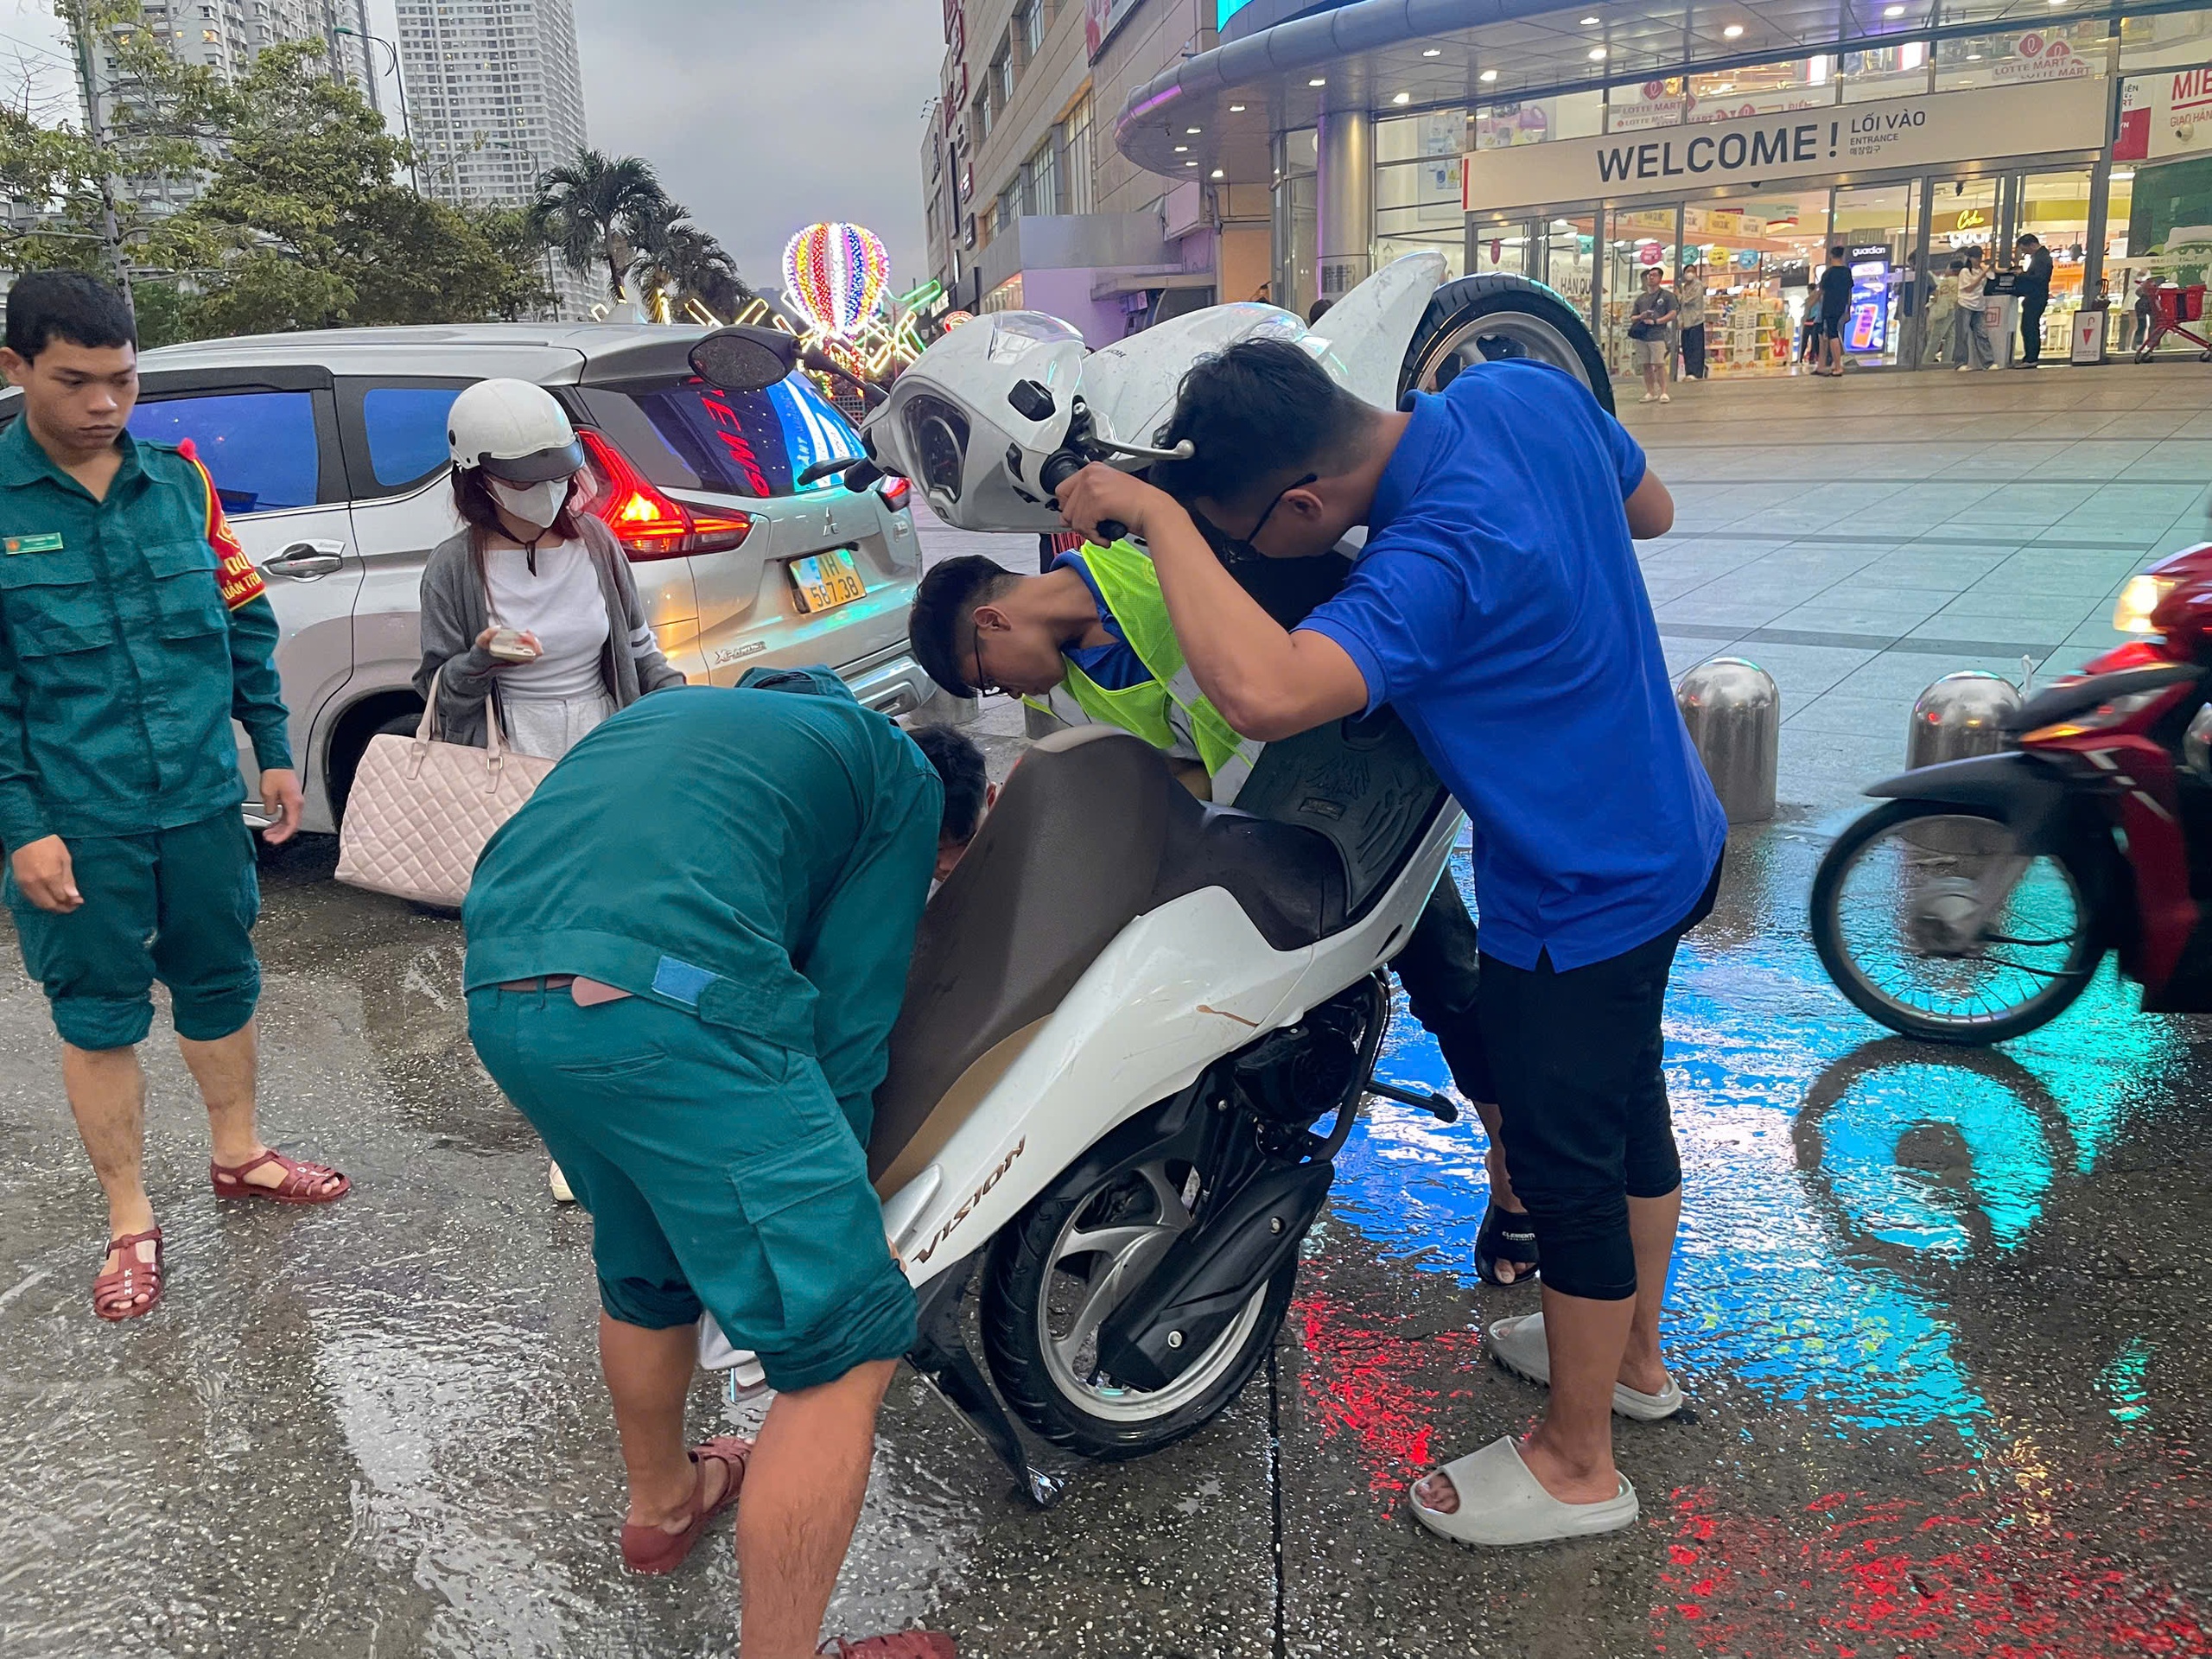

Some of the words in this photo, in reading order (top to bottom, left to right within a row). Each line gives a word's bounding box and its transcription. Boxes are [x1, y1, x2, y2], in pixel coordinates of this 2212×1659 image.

[1995, 64, 2031, 75] LOTTE
[2033, 58, 2066, 69] MART
[1623, 105, 1651, 114] LOTTE
[1654, 101, 1682, 111] MART
[1851, 112, 1880, 134] LỐI
[1885, 108, 1926, 129] VÀO
[1850, 133, 1899, 146] ENTRANCE
[1597, 124, 1818, 182] WELCOME
[1852, 245, 1886, 257] guardian
[810, 575, 859, 607] 587.38
[910, 1134, 1027, 1264] VISION
